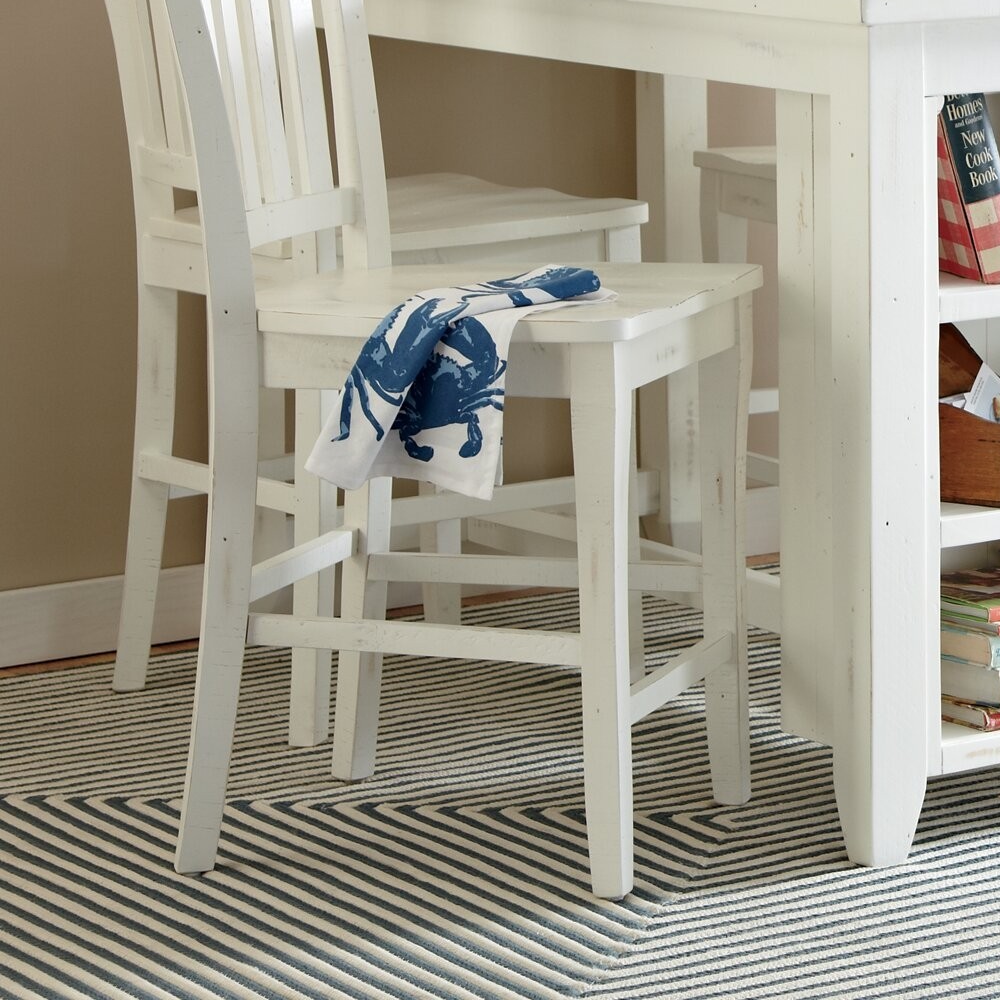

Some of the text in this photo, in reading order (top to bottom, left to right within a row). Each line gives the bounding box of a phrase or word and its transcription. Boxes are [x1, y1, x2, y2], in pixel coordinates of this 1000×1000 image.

[946, 97, 984, 121] Homes
[960, 128, 985, 149] New
[965, 146, 993, 169] Cook
[969, 166, 998, 188] Book
